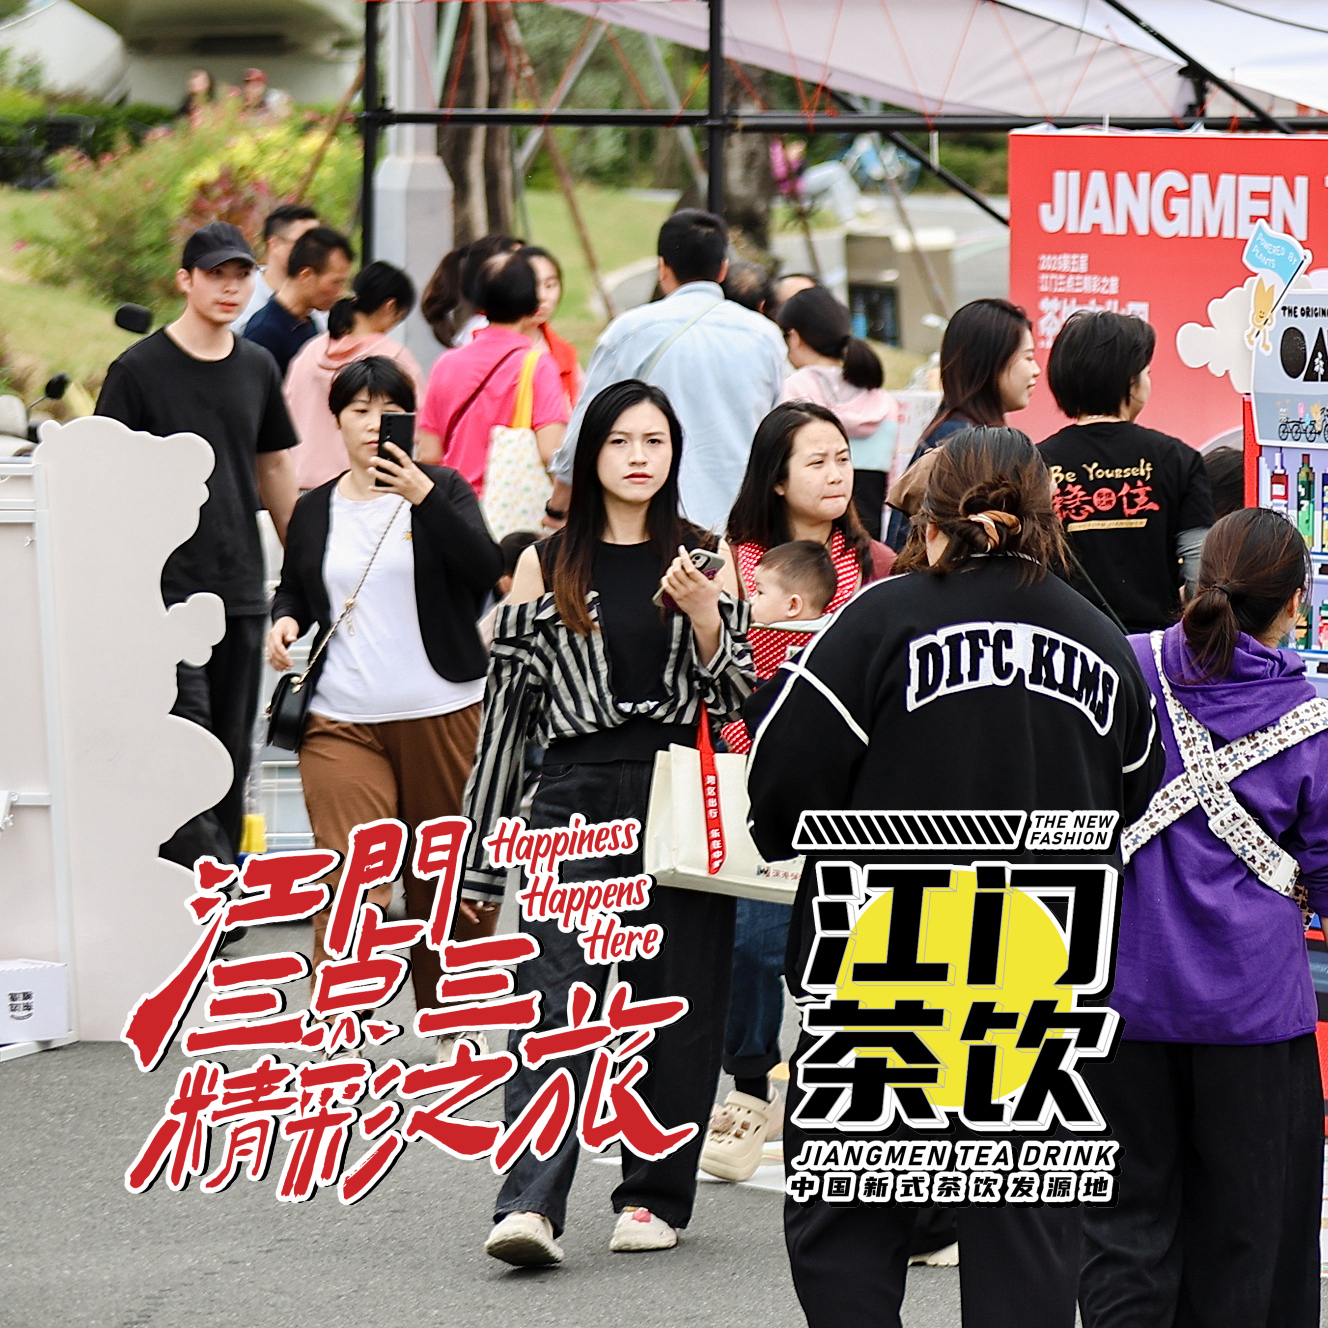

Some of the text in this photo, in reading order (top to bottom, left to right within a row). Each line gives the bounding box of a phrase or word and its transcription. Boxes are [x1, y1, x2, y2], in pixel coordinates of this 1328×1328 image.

[1039, 170, 1309, 241] JIANGMEN
[1252, 247, 1276, 269] PLANTS
[1256, 232, 1298, 266] POWERED BY
[1281, 306, 1298, 318] THE
[1050, 457, 1153, 485] Be Yourself
[915, 629, 1014, 702] DIFC
